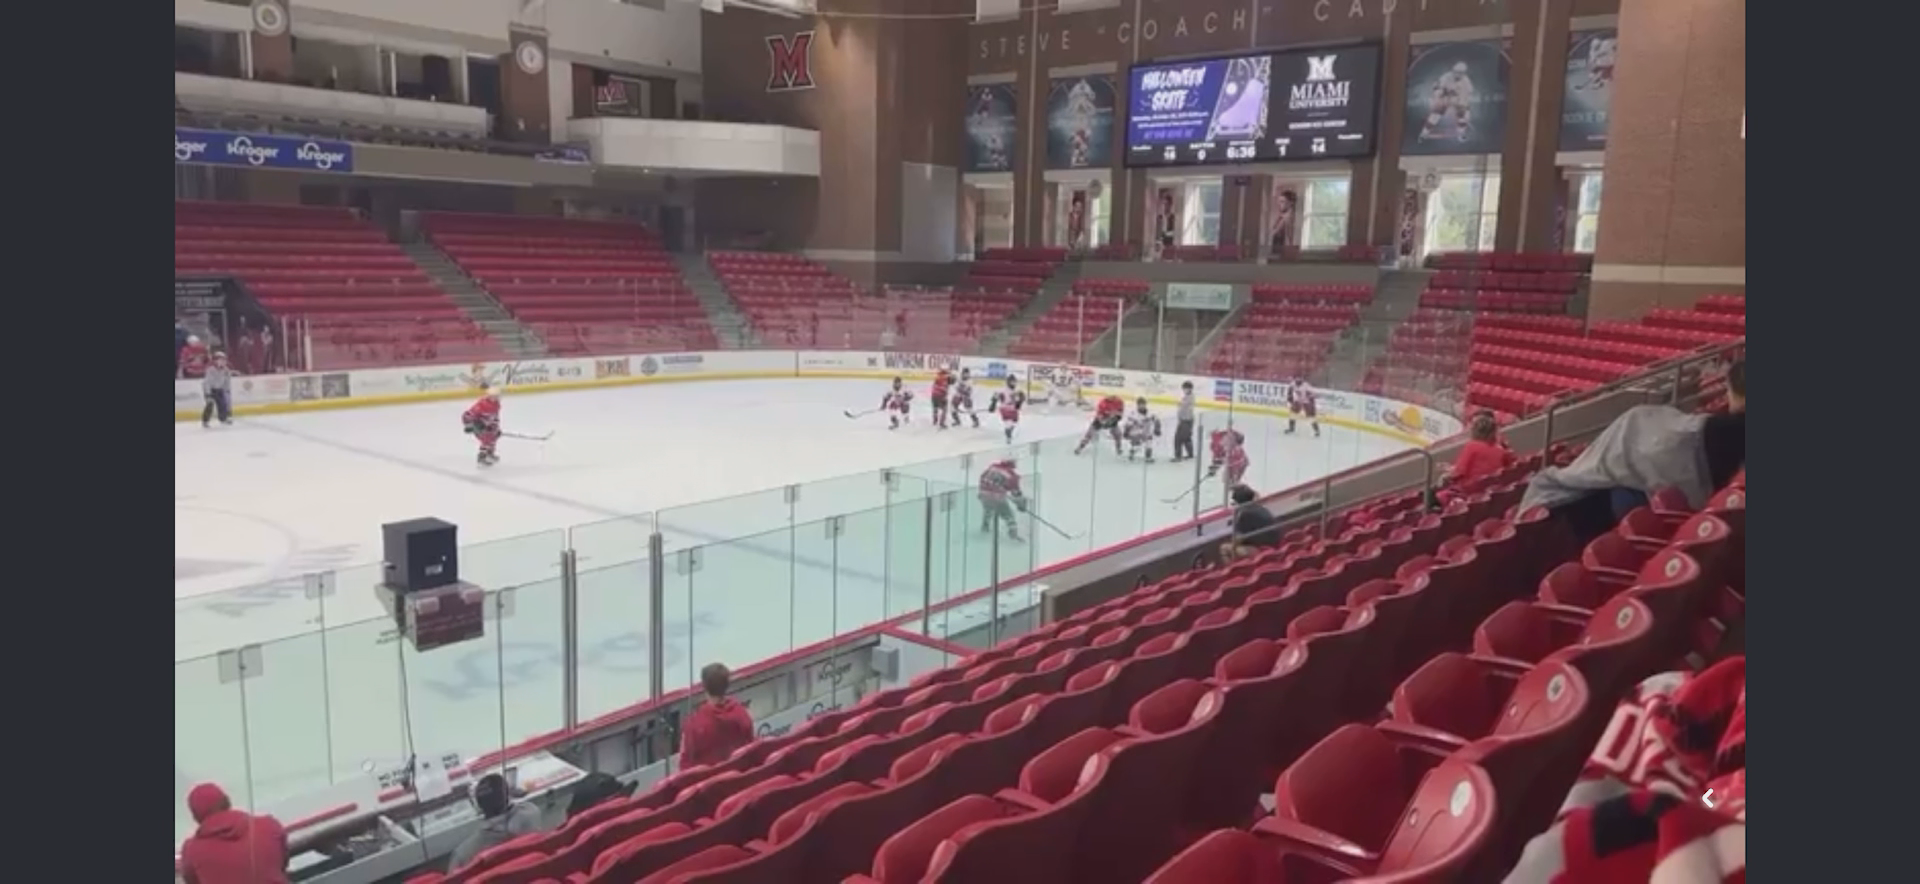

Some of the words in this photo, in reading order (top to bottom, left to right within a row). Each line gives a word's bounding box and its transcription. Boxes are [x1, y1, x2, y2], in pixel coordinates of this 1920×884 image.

[980, 30, 1070, 58] STEVE
[765, 31, 816, 92] M
[1306, 55, 1337, 81] M
[1288, 98, 1349, 109] UNIVERSITY
[1290, 81, 1351, 100] MIAMI
[227, 136, 280, 165] Kroger
[296, 142, 345, 169] Kroger
